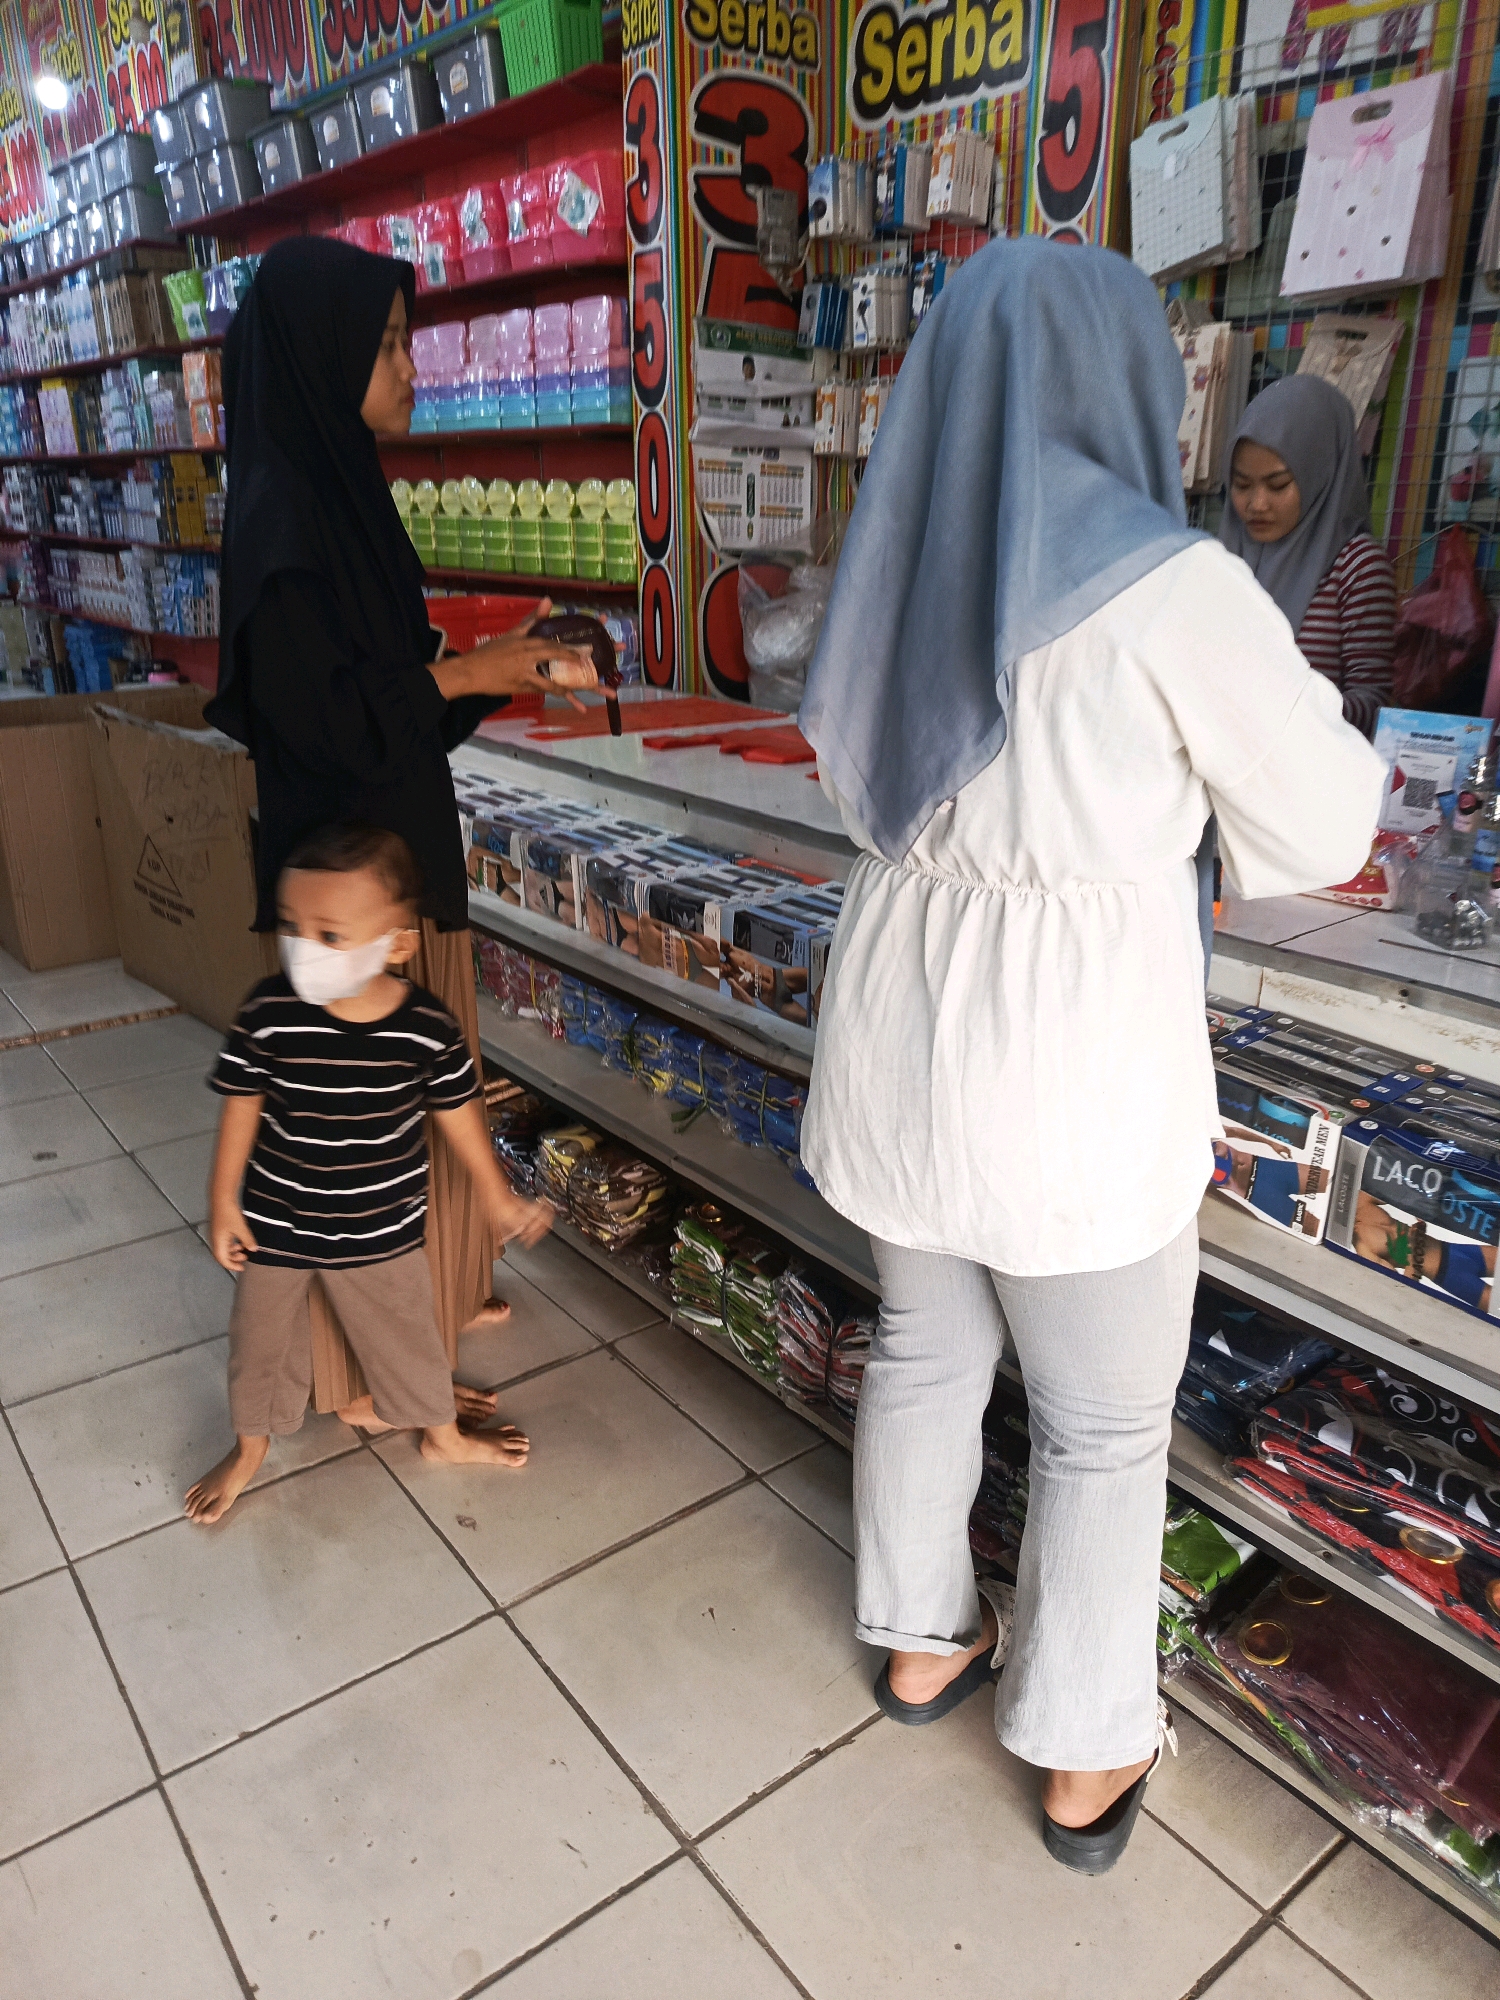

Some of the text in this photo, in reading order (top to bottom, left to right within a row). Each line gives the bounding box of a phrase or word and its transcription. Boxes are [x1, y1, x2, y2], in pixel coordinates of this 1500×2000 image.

[621, 0, 660, 50] Serba
[688, 0, 817, 66] Serba
[859, 0, 1023, 105] Serba
[1317, 1123, 1330, 1147] MEN
[1372, 1155, 1443, 1194] LACO
[1441, 1191, 1497, 1240] OSTE
